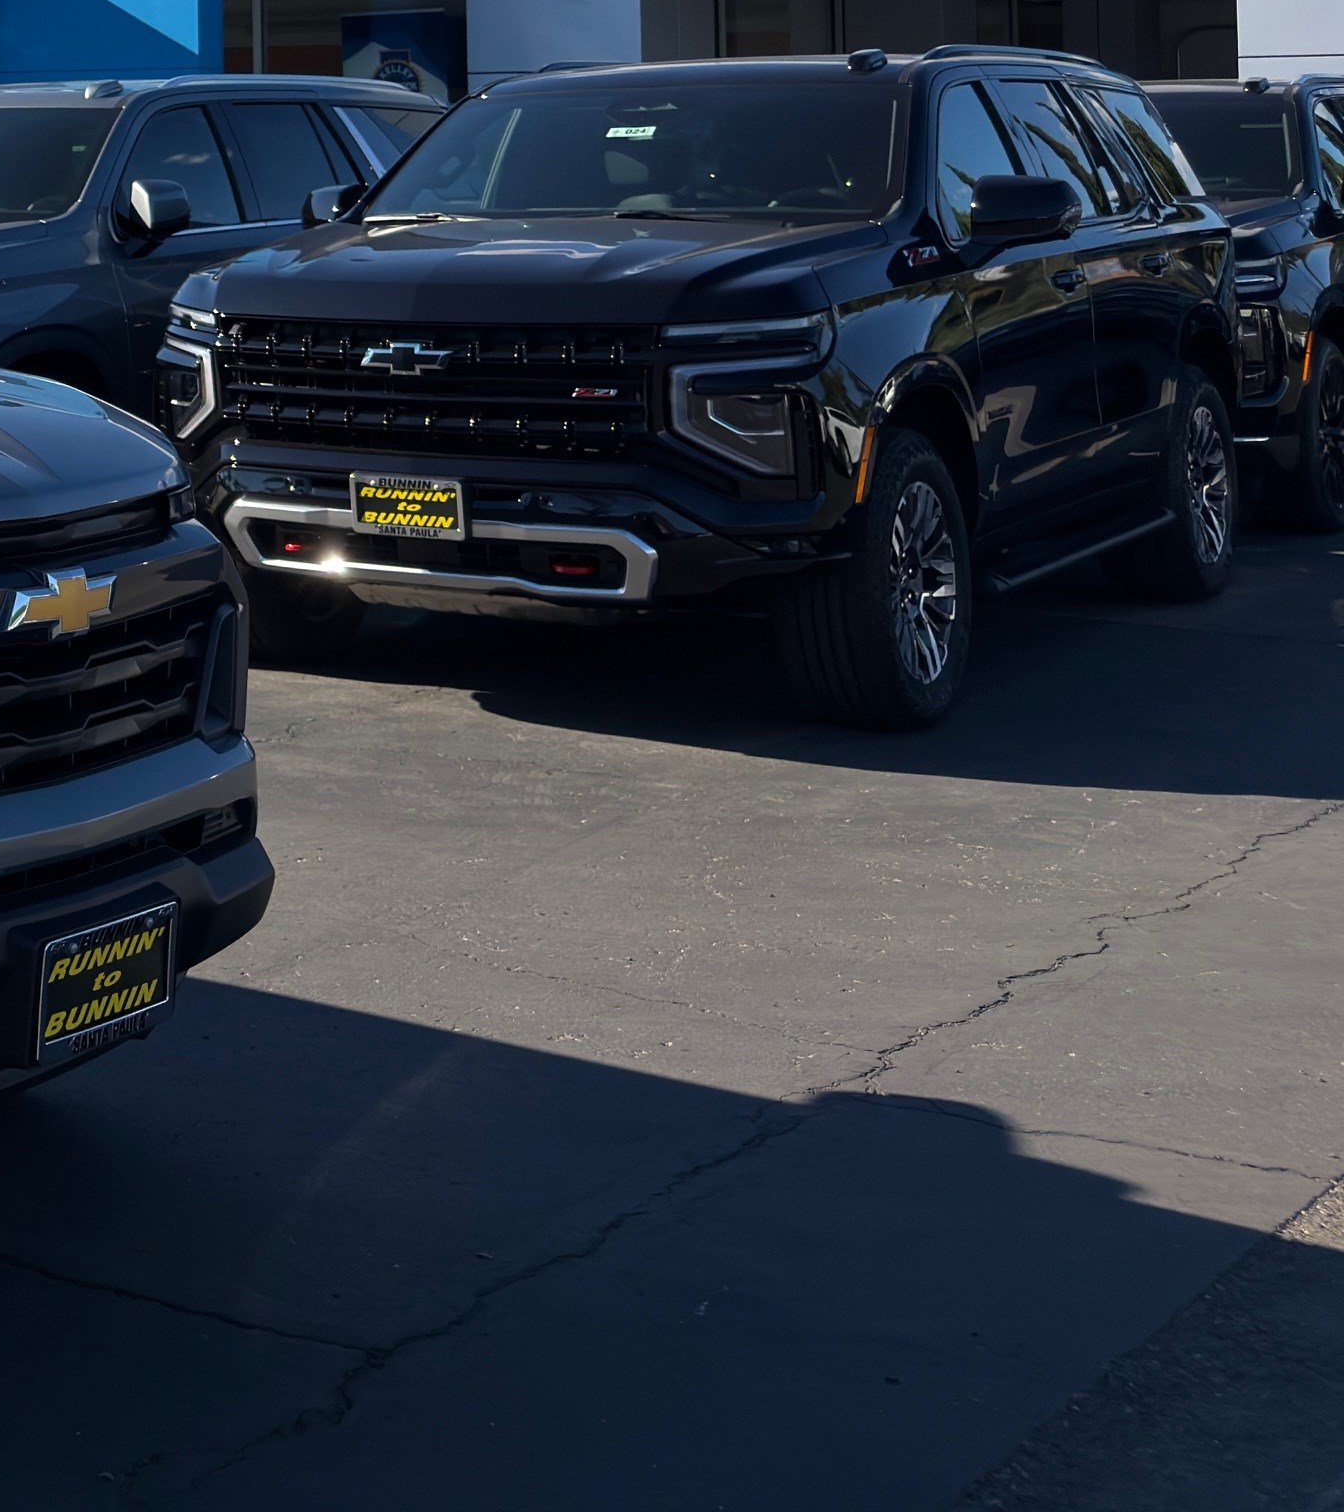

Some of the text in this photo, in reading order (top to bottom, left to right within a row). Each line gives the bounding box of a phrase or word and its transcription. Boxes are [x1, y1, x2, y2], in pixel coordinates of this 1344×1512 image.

[378, 477, 432, 490] BUNNIN
[360, 486, 457, 503] RUNNIN'
[396, 501, 423, 512] to
[361, 510, 455, 529] BUNNIN
[47, 925, 166, 984] RUNNIN'
[91, 969, 123, 992] to
[43, 978, 159, 1039] BUNNIN
